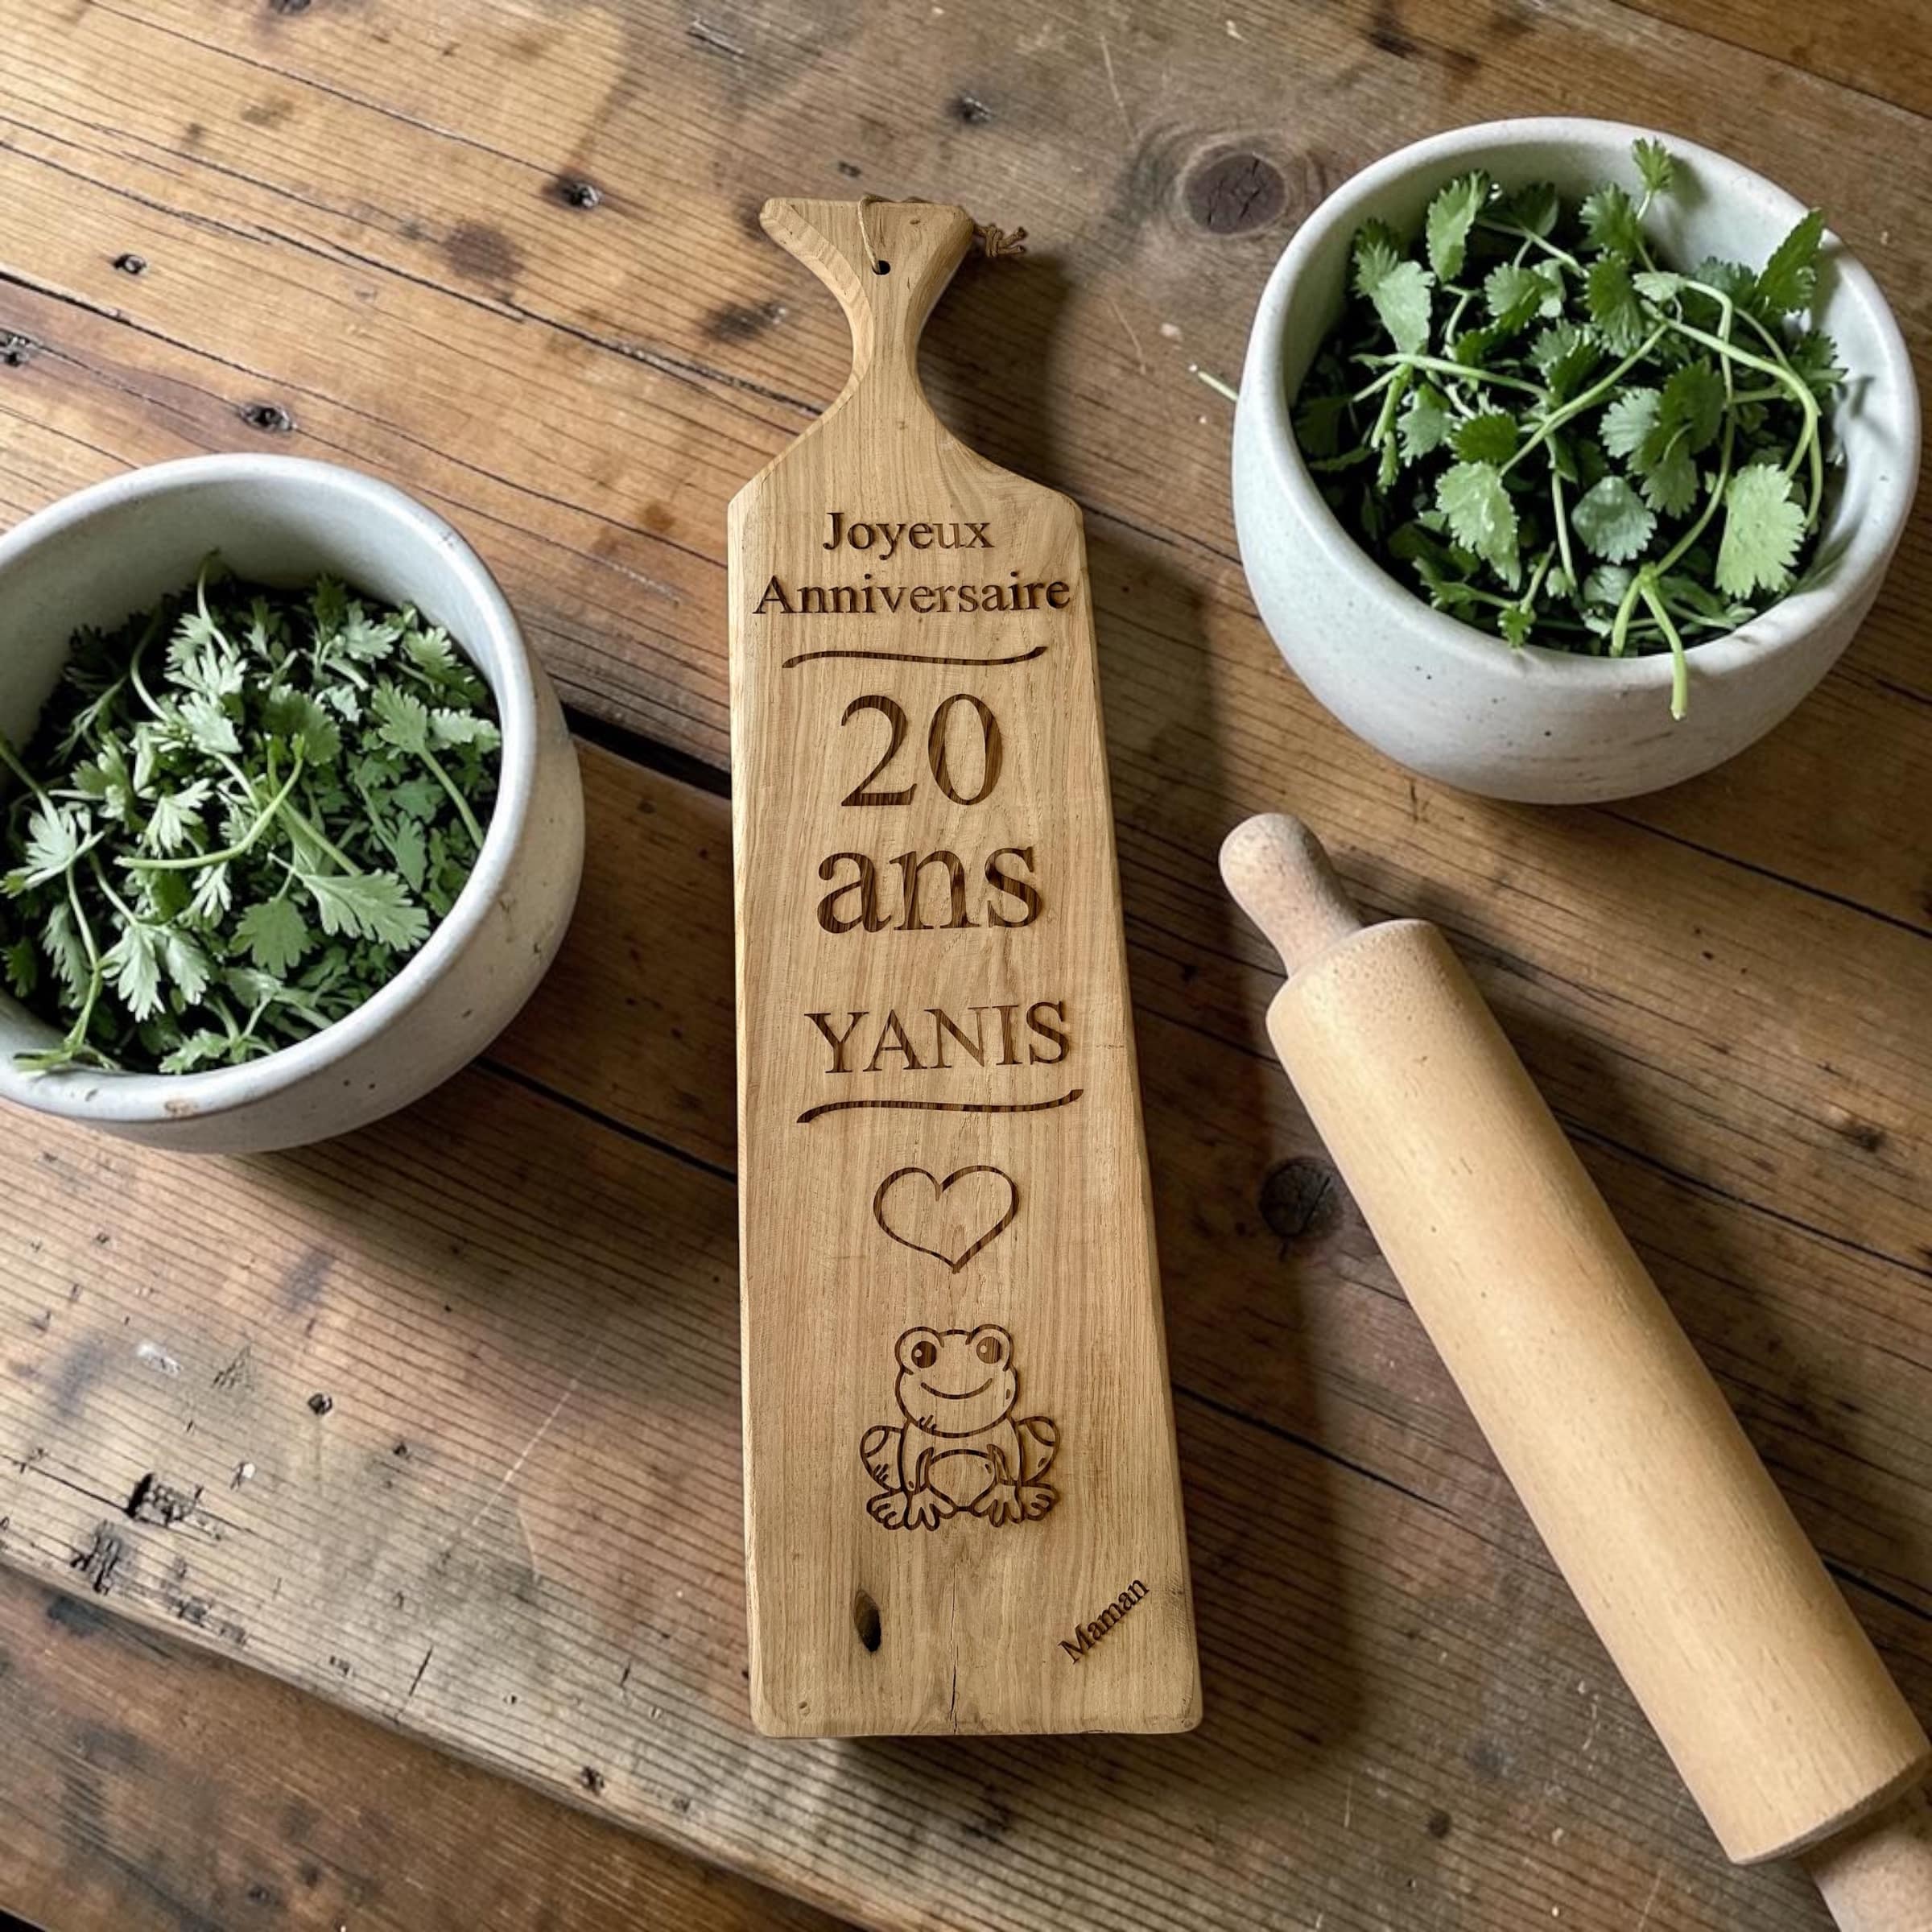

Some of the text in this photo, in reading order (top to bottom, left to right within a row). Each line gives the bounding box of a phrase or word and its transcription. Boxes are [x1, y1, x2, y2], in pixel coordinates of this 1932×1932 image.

[823, 512, 995, 561] Joyeux
[752, 571, 1071, 615] Anniversaire
[840, 693, 1004, 807] 20
[817, 846, 1043, 934] ans
[803, 1000, 1071, 1074] YANIS
[1057, 1579, 1150, 1664] Maman
